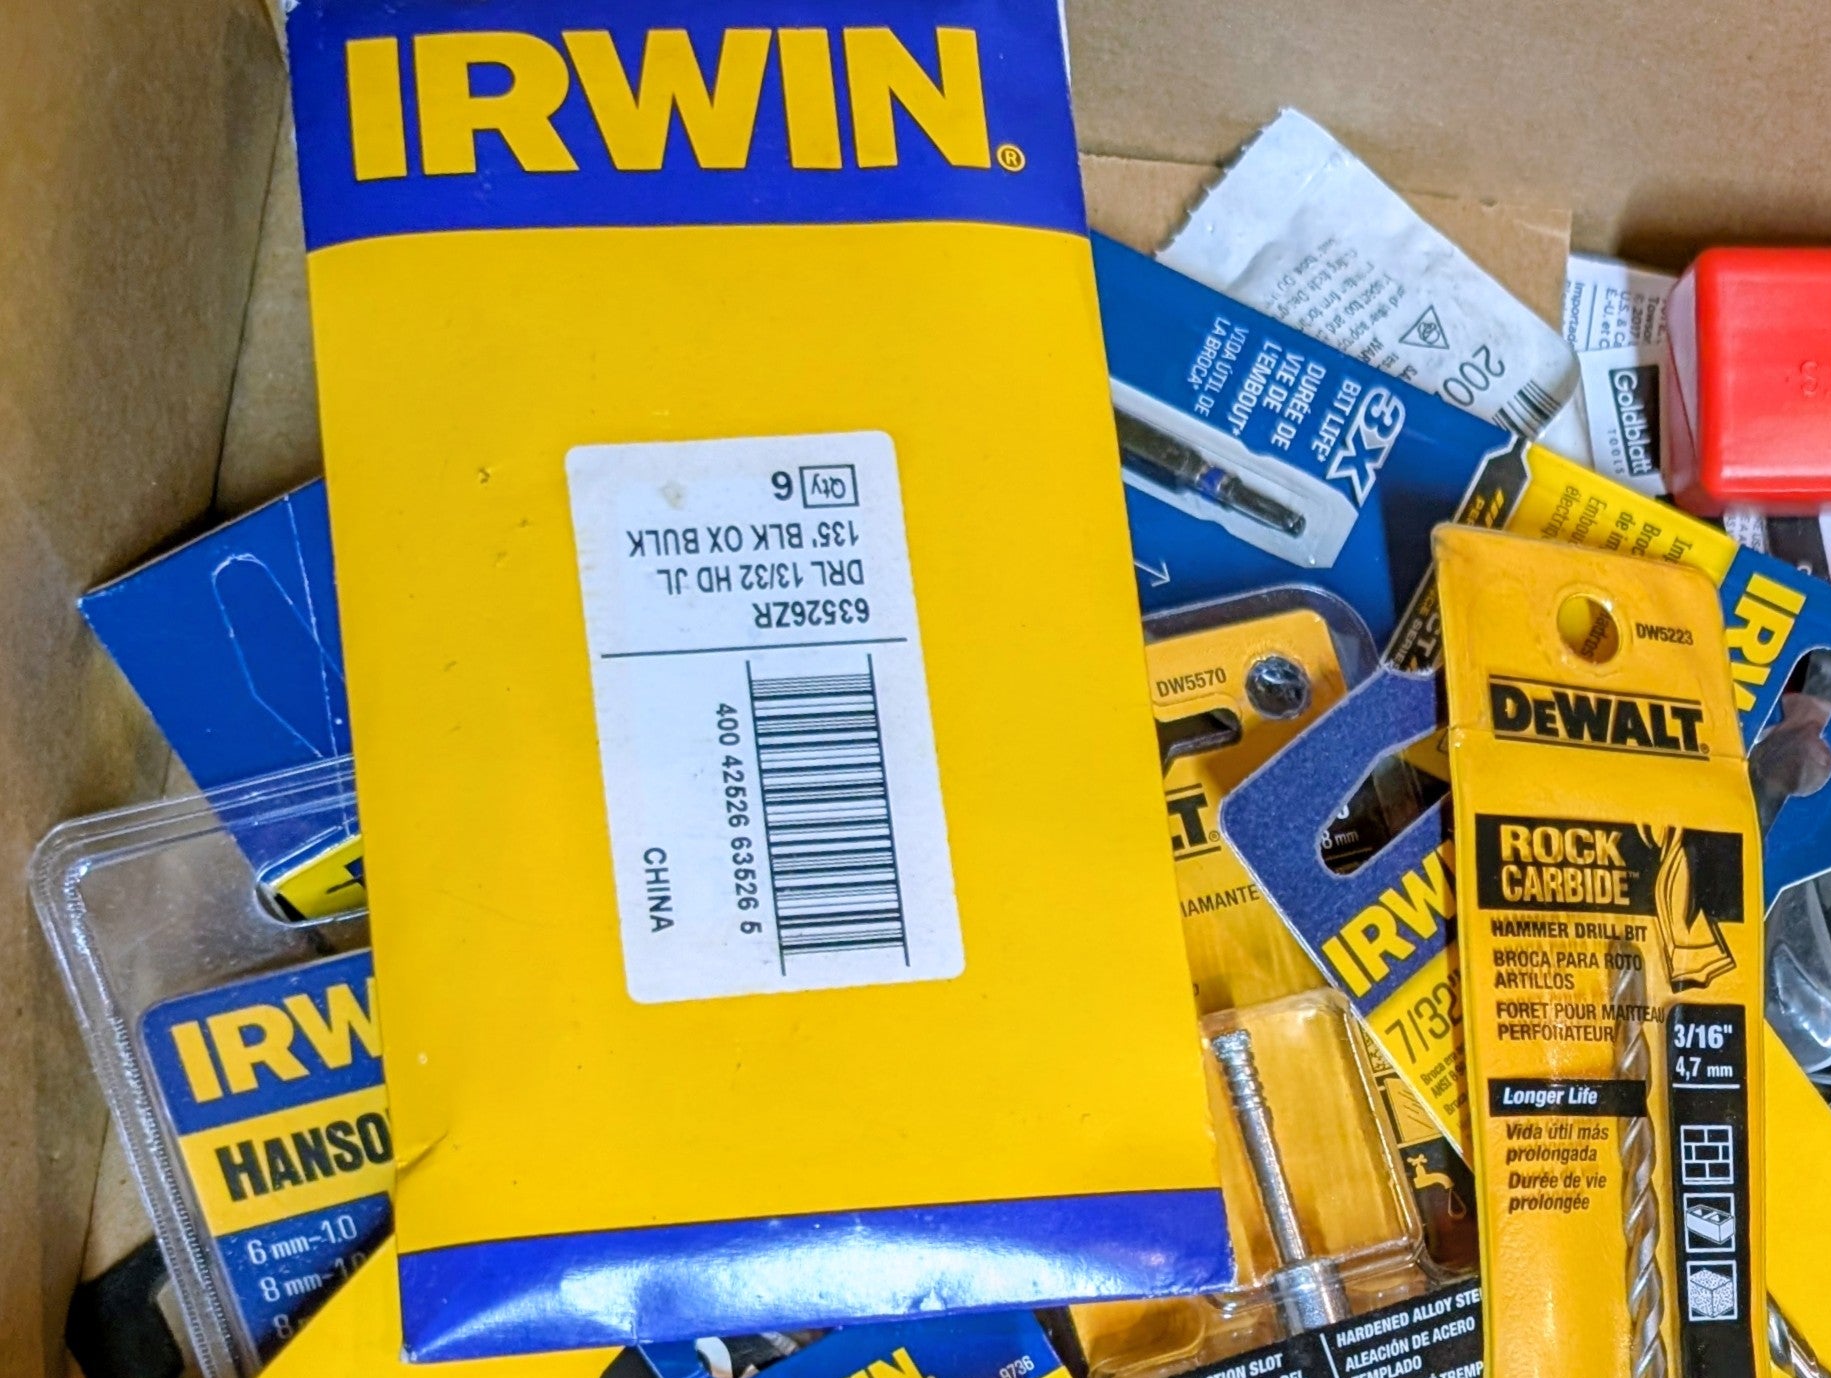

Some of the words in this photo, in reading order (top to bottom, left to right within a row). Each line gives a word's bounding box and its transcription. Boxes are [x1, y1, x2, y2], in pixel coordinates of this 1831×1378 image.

[1220, 325, 1250, 362] VIDA
[1275, 352, 1305, 387] VIE
[1194, 395, 1216, 417] DE
[1262, 384, 1289, 414] DE
[1284, 361, 1327, 425] DURÉE
[1333, 378, 1362, 417] BIT
[1271, 421, 1297, 451] DE
[1613, 369, 1653, 475] Goldblatt
[810, 468, 847, 500] Qty
[629, 529, 700, 557] BULK
[710, 525, 743, 552] OX
[754, 524, 802, 549] BLK
[699, 565, 733, 593] HD
[740, 561, 802, 590] 13/32
[811, 559, 865, 585] DRL
[754, 597, 871, 628] 63526ZR
[1635, 622, 1694, 646] DW5223
[1155, 667, 1227, 698] DW5570
[716, 703, 741, 746] 400
[1489, 682, 1706, 755] DEWALT
[720, 755, 751, 828] 42526
[1500, 824, 1628, 868] ROCK
[731, 837, 761, 910] 63526
[643, 847, 675, 932] CHINA
[740, 921, 763, 936] 5
[1490, 920, 1570, 940] HAMMER
[1625, 925, 1648, 943] BIT
[1493, 950, 1552, 970] BROCA
[1604, 953, 1643, 972] ROTO
[1494, 971, 1575, 990] ARTILLOS
[1496, 1002, 1549, 1021] FORET
[1601, 1004, 1666, 1024] MARTEAU
[1706, 1062, 1734, 1078] mm
[1502, 1087, 1566, 1107] Longer
[1568, 1087, 1599, 1106] Life
[214, 1111, 393, 1203] HANSO
[1505, 1144, 1598, 1166] prolongada
[246, 1237, 269, 1266] 6
[259, 1275, 282, 1302] 8
[1335, 1312, 1410, 1348] HARDENED
[1412, 1297, 1455, 1322] ALLOY
[1432, 1316, 1476, 1343] ACERO
[1248, 1353, 1284, 1378] SLOT
